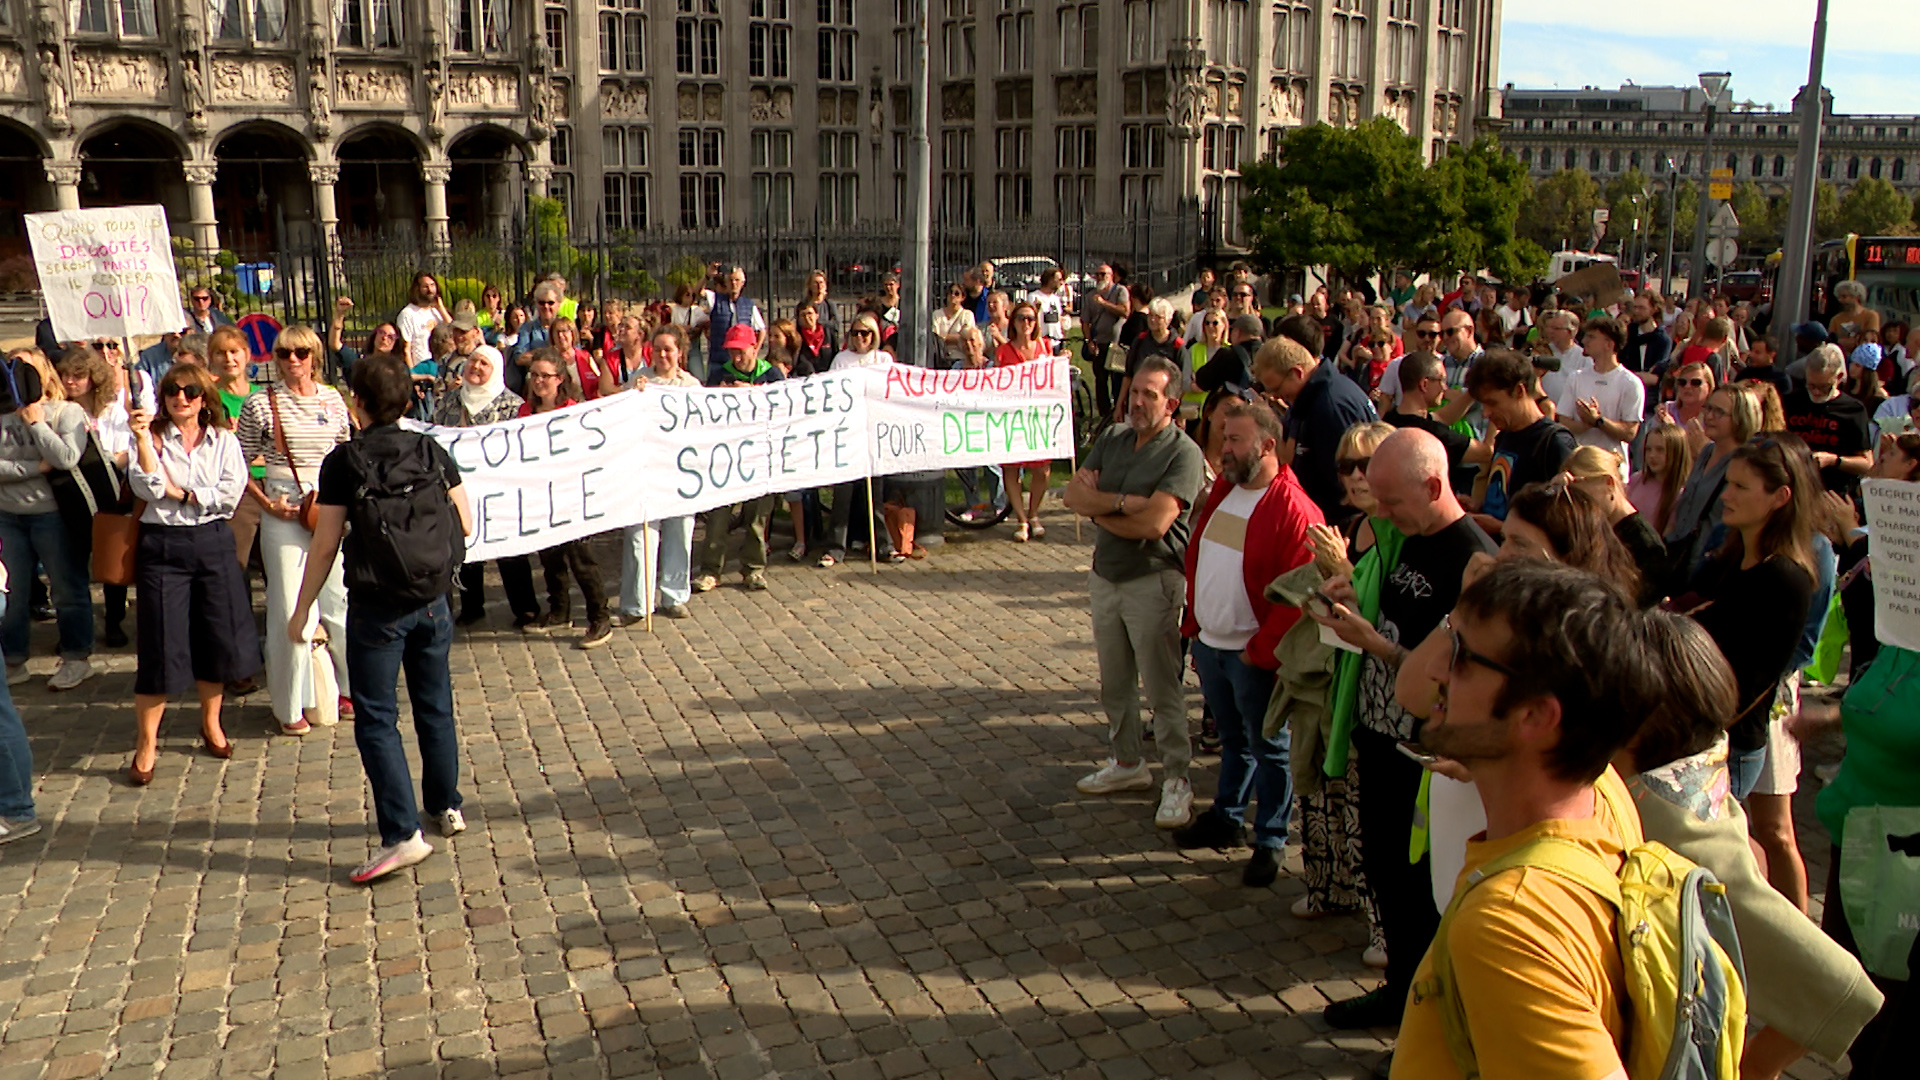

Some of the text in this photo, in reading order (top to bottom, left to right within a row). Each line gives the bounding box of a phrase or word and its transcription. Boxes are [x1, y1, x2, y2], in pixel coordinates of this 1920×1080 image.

[42, 222, 95, 243] QUAND
[104, 220, 135, 232] TOUS
[1867, 245, 1882, 262] 11
[46, 259, 92, 275] SERONT
[68, 271, 153, 289] IL RESTERA
[424, 407, 606, 473] COLES
[677, 417, 850, 499] SOCIÉTÉ
[877, 421, 927, 460] POUR
[1881, 503, 1894, 515] LE
[1887, 551, 1915, 564] VOTE
[1893, 574, 1916, 586] PEU
[1889, 603, 1909, 615] PAS
